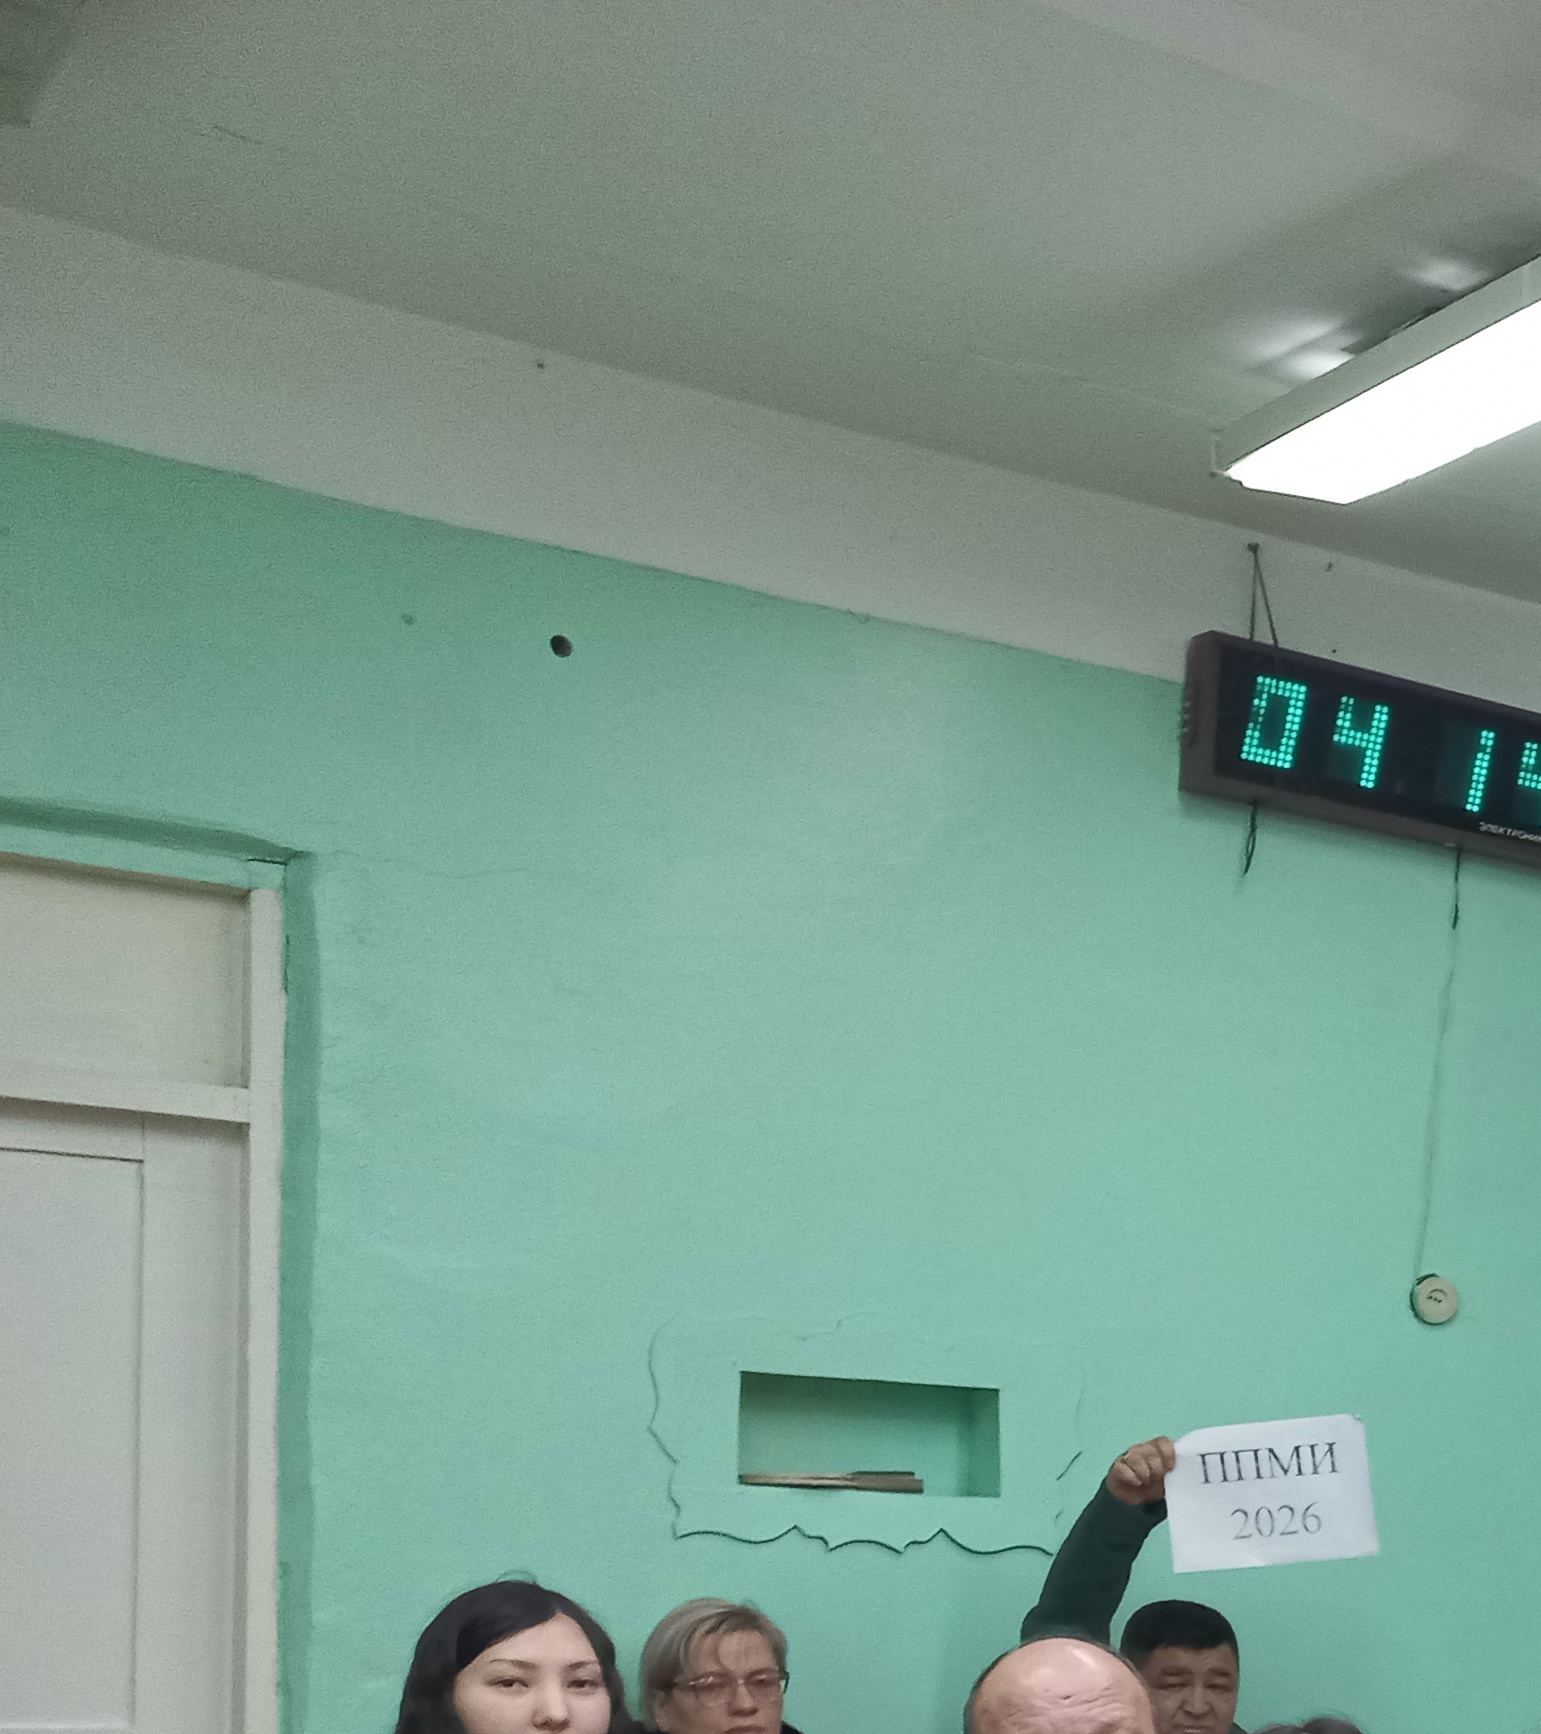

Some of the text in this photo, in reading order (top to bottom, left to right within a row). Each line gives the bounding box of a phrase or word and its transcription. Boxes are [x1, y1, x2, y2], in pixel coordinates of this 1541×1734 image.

[1240, 675, 1390, 788] 04
[1199, 1442, 1340, 1485] ППМИ
[1230, 1501, 1323, 1540] 2026
